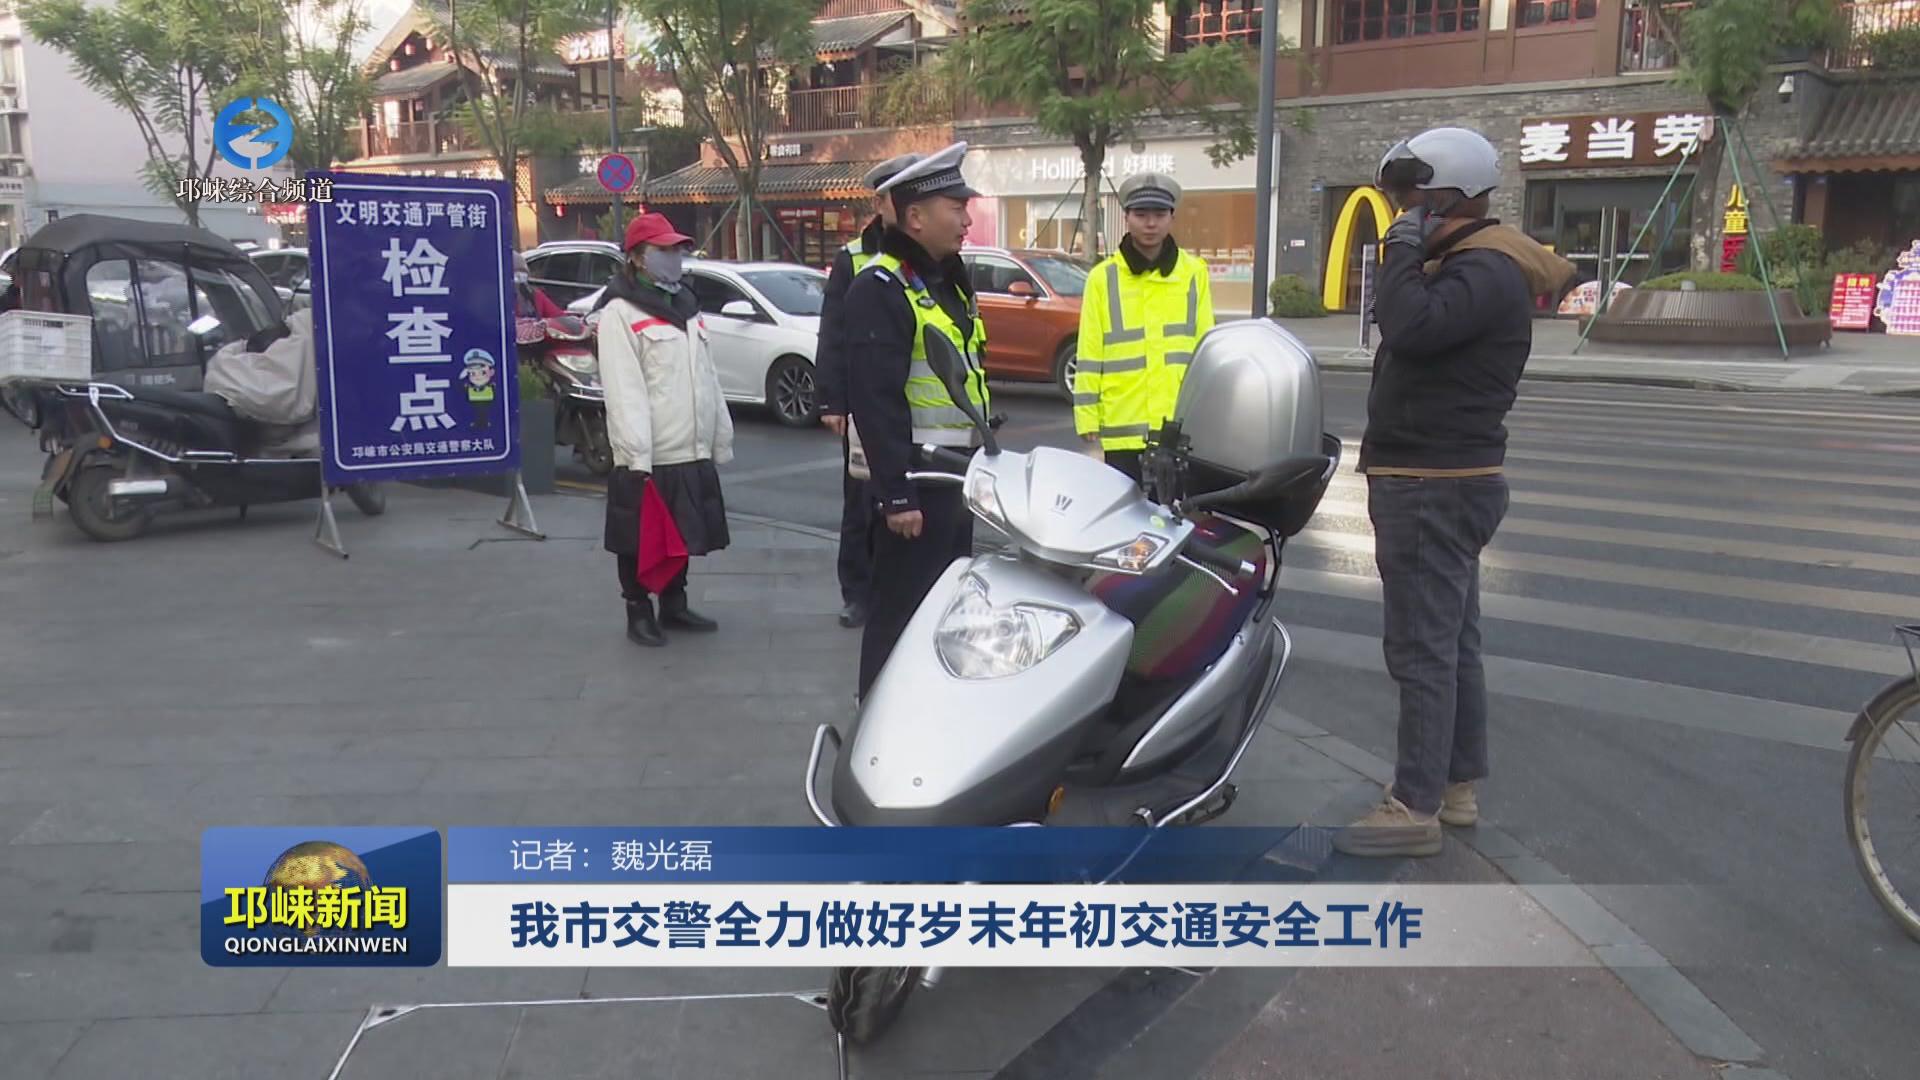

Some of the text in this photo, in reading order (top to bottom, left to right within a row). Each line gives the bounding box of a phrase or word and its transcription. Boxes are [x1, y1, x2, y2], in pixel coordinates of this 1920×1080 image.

[1520, 114, 1705, 163] 麦当劳
[1121, 152, 1176, 175] 好利来
[335, 198, 488, 229] 文明交通严管街
[381, 237, 457, 432] 检查点
[351, 438, 495, 458] 邛崃市公安局交通警察大队
